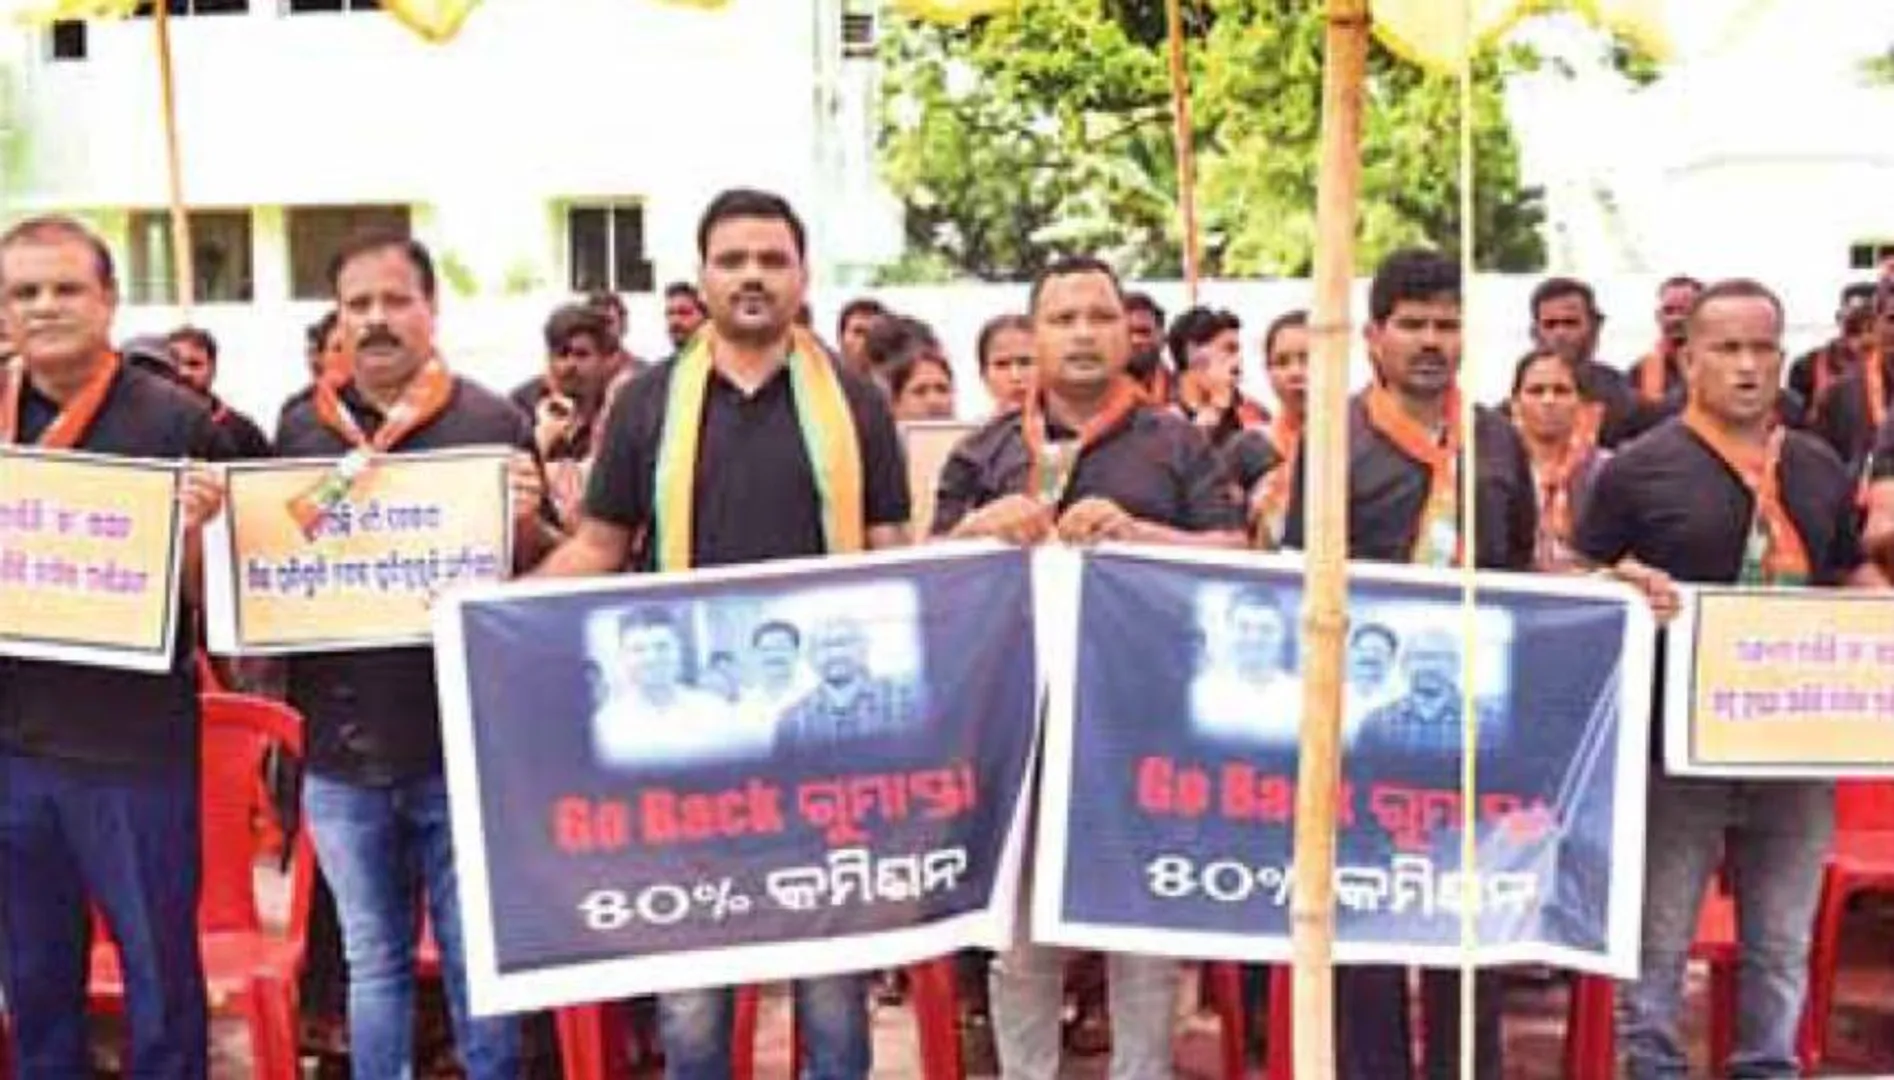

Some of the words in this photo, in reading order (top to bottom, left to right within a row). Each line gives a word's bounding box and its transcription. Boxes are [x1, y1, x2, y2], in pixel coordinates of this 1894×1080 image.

[554, 794, 628, 853] Go
[640, 776, 784, 844] Back
[1137, 755, 1210, 818] Go
[1221, 761, 1355, 827] Ba
